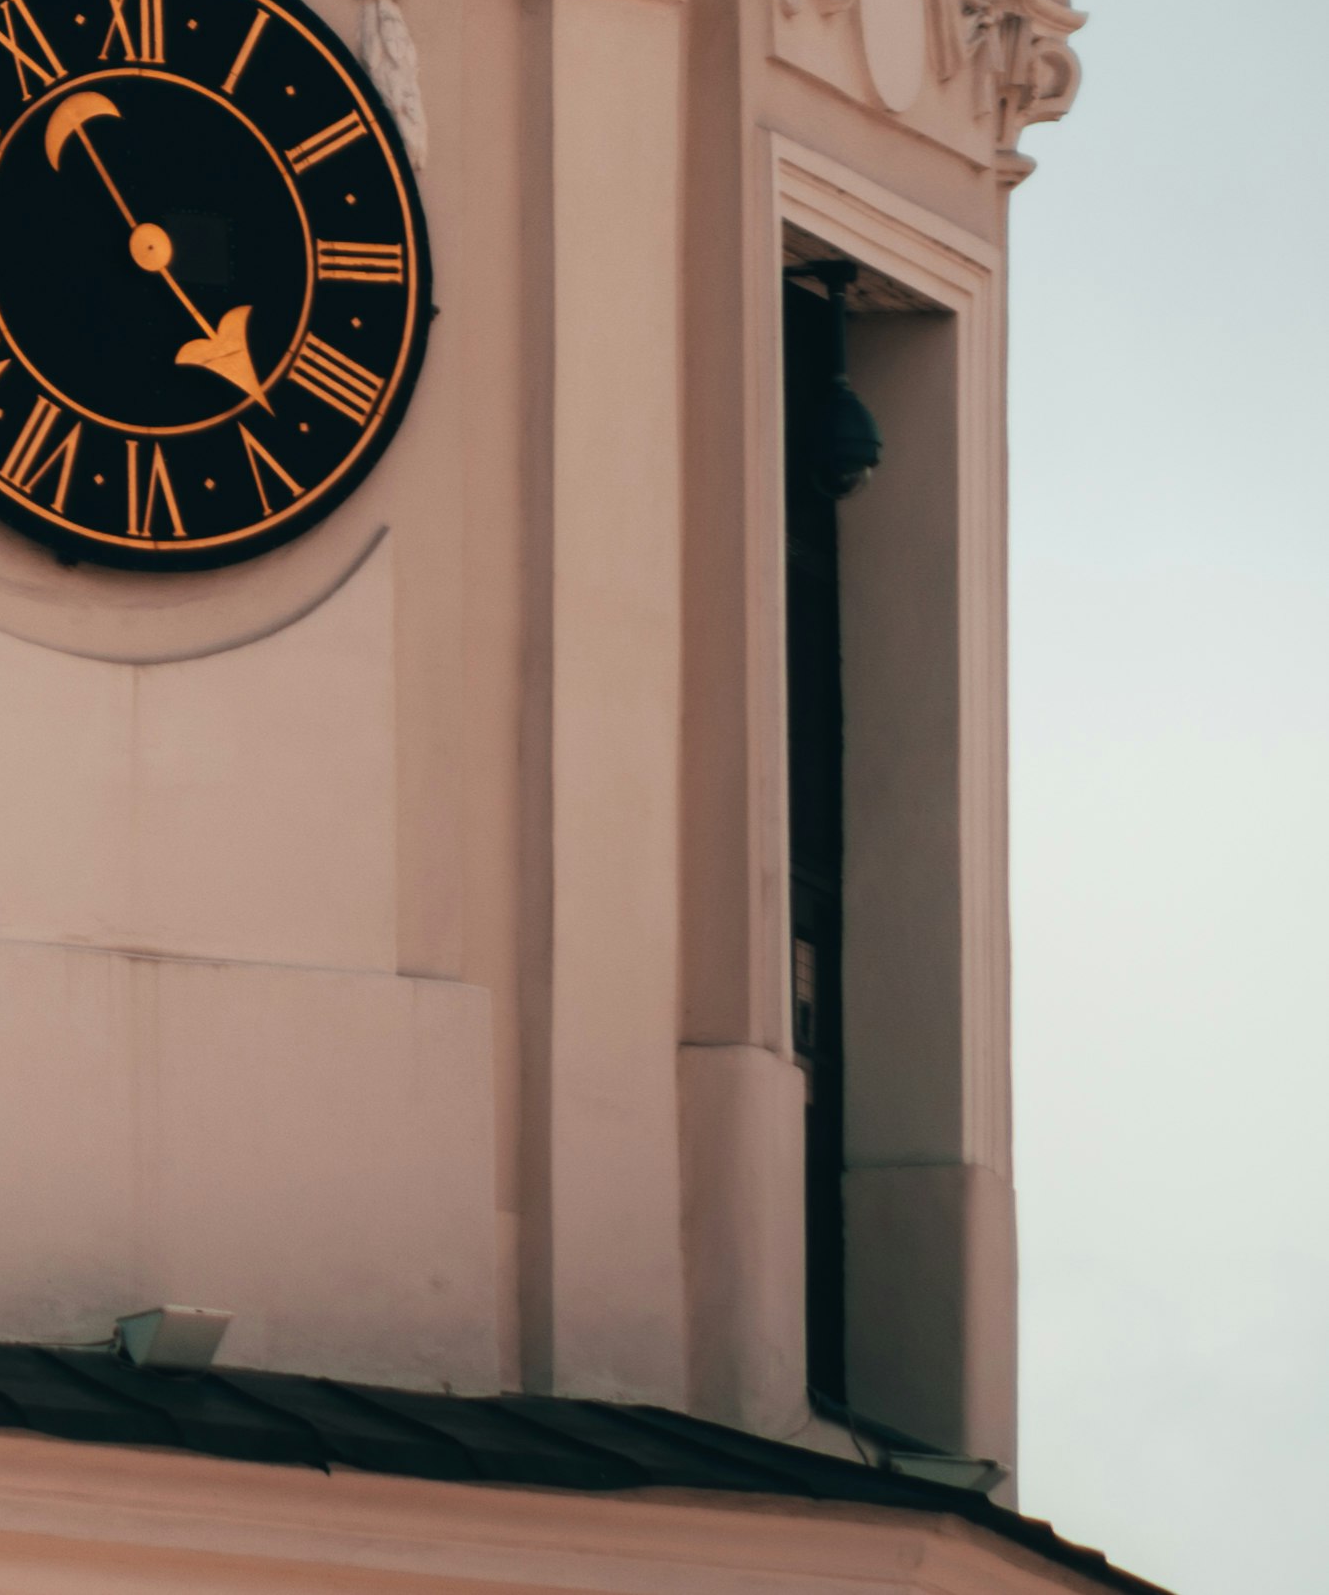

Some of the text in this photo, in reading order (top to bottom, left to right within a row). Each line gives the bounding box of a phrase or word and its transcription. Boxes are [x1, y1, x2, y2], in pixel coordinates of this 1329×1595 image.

[222, 9, 270, 94] I
[286, 110, 368, 174] II
[317, 238, 404, 283] III
[287, 332, 385, 426] IIII
[0, 395, 81, 513] VII
[126, 440, 187, 537] VI
[238, 421, 305, 516] V
